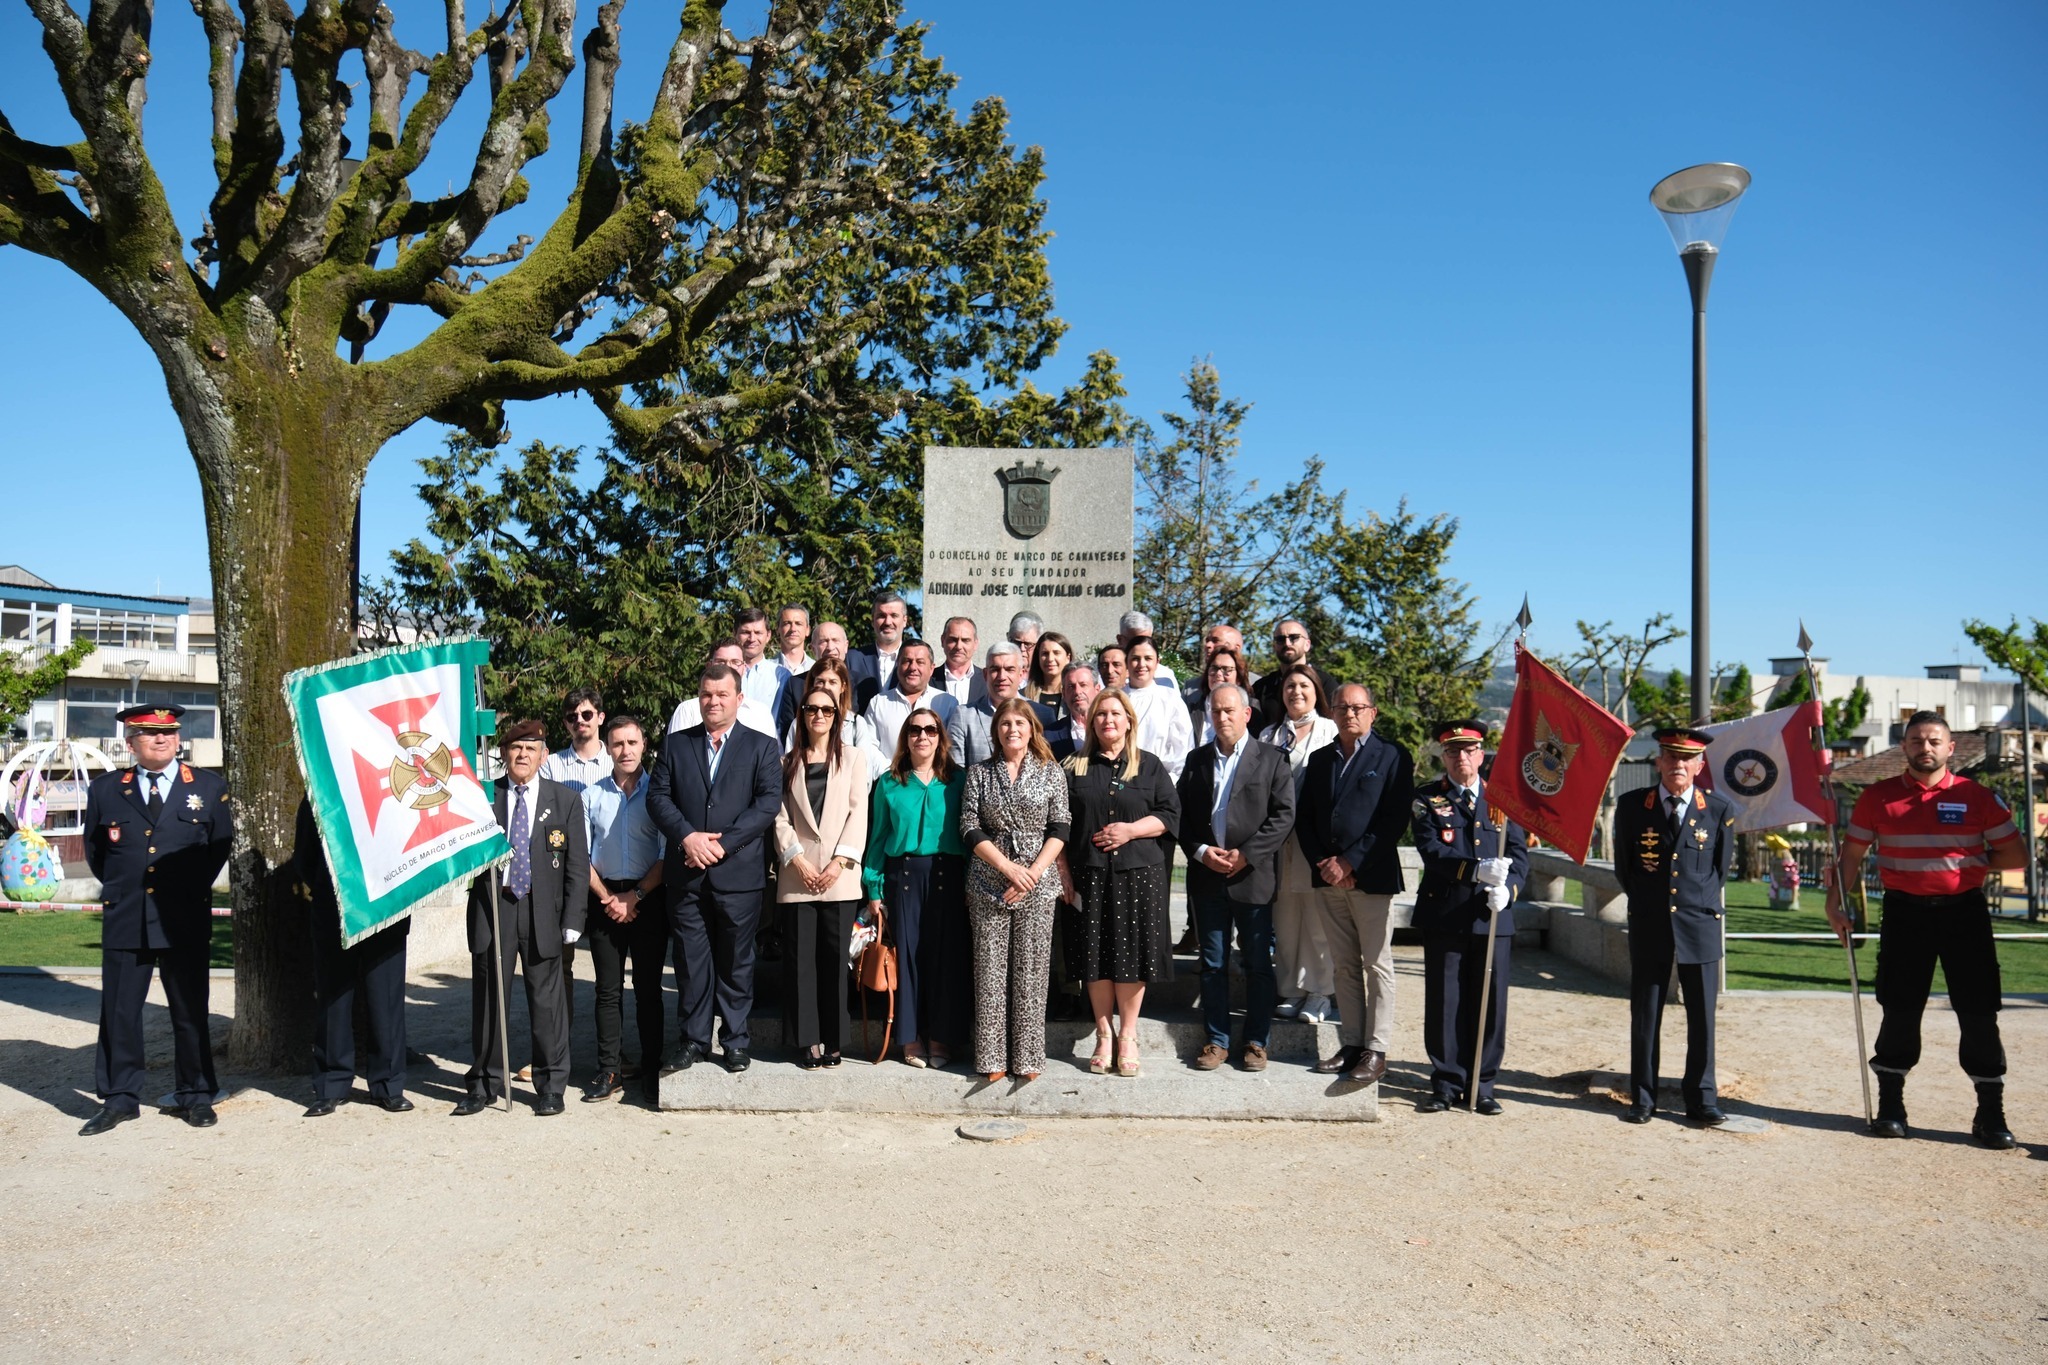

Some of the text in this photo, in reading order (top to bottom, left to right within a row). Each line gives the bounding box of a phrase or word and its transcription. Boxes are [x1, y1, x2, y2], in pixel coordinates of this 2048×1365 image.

[929, 550, 1126, 561] O CONCELHO DE MARCO DE CANAVESES
[968, 567, 1087, 577] AO SEU FUNDADOR
[928, 581, 973, 596] ADRIANO
[1012, 585, 1024, 595] DE
[1027, 583, 1083, 598] CARVALHO
[1094, 583, 1126, 598] MELO
[1523, 751, 1541, 773] MARCO
[1527, 774, 1540, 787] DE
[383, 863, 408, 883] NÚCLEO
[408, 856, 418, 867] DE
[419, 843, 446, 860] MARCO
[448, 837, 457, 847] DE
